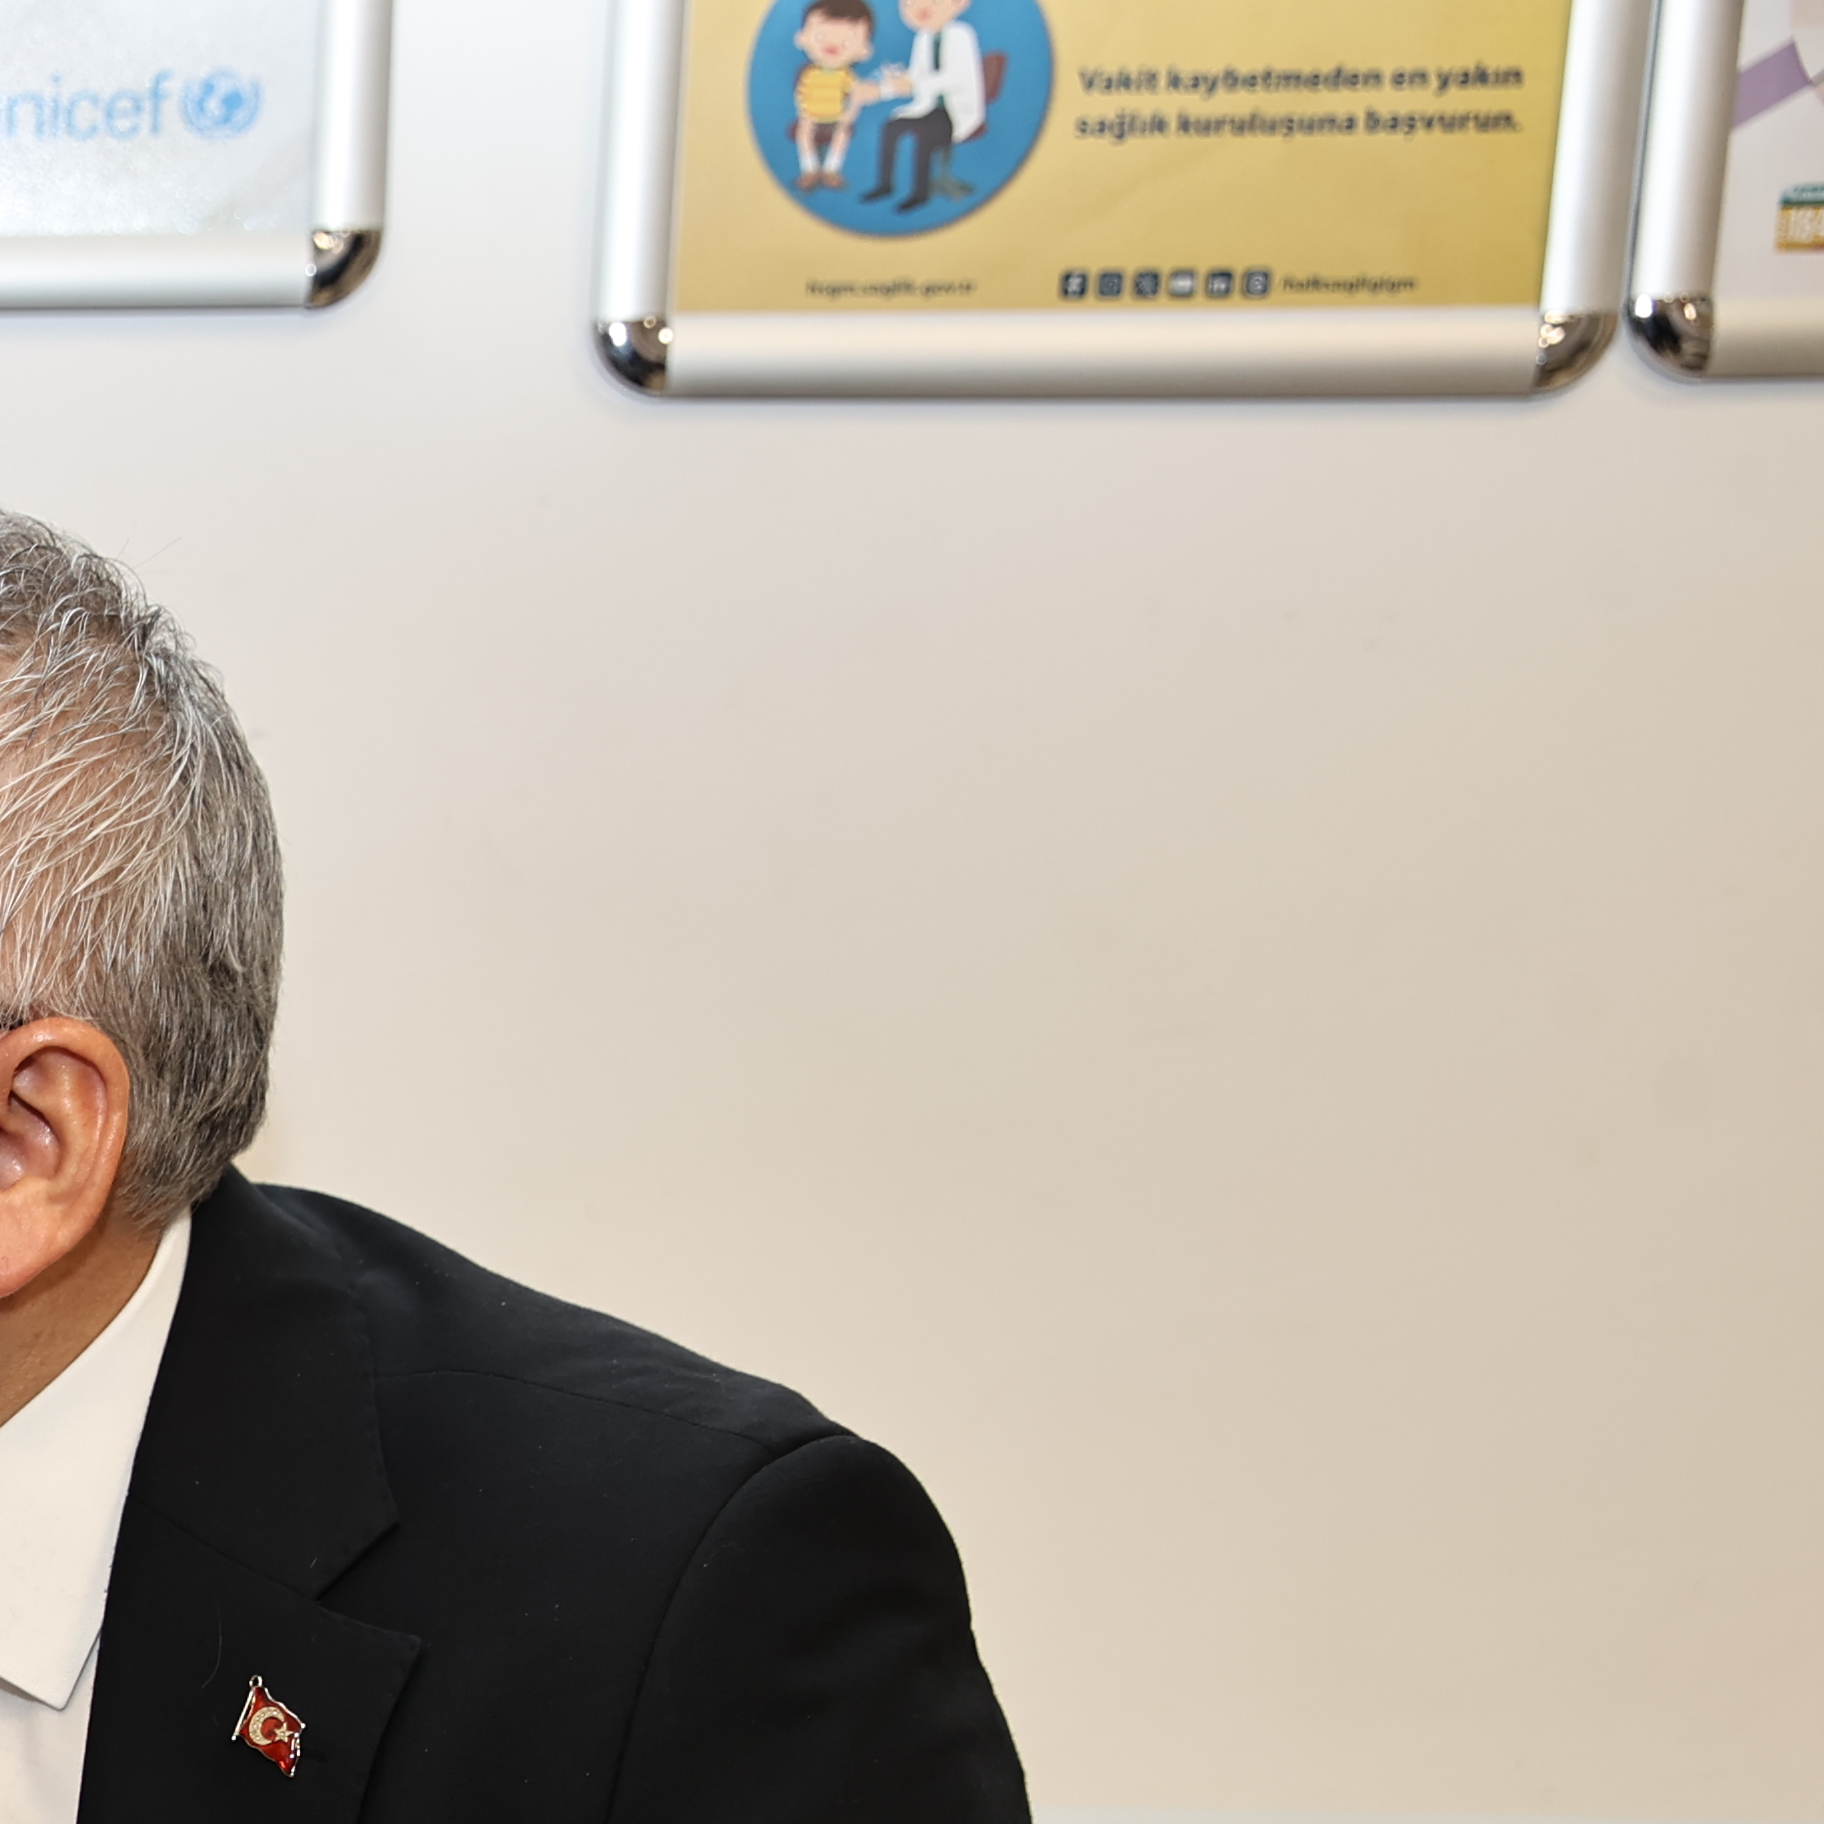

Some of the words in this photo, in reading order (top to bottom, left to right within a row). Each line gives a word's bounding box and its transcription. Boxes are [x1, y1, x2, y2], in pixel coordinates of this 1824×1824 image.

[1078, 67, 1158, 94] Vakit
[1167, 66, 1382, 99] kaybetmeden
[1390, 69, 1427, 89] en
[1435, 60, 1523, 97] yakın
[1075, 108, 1168, 144] sağlık
[1177, 109, 1355, 141] kuruluşuna
